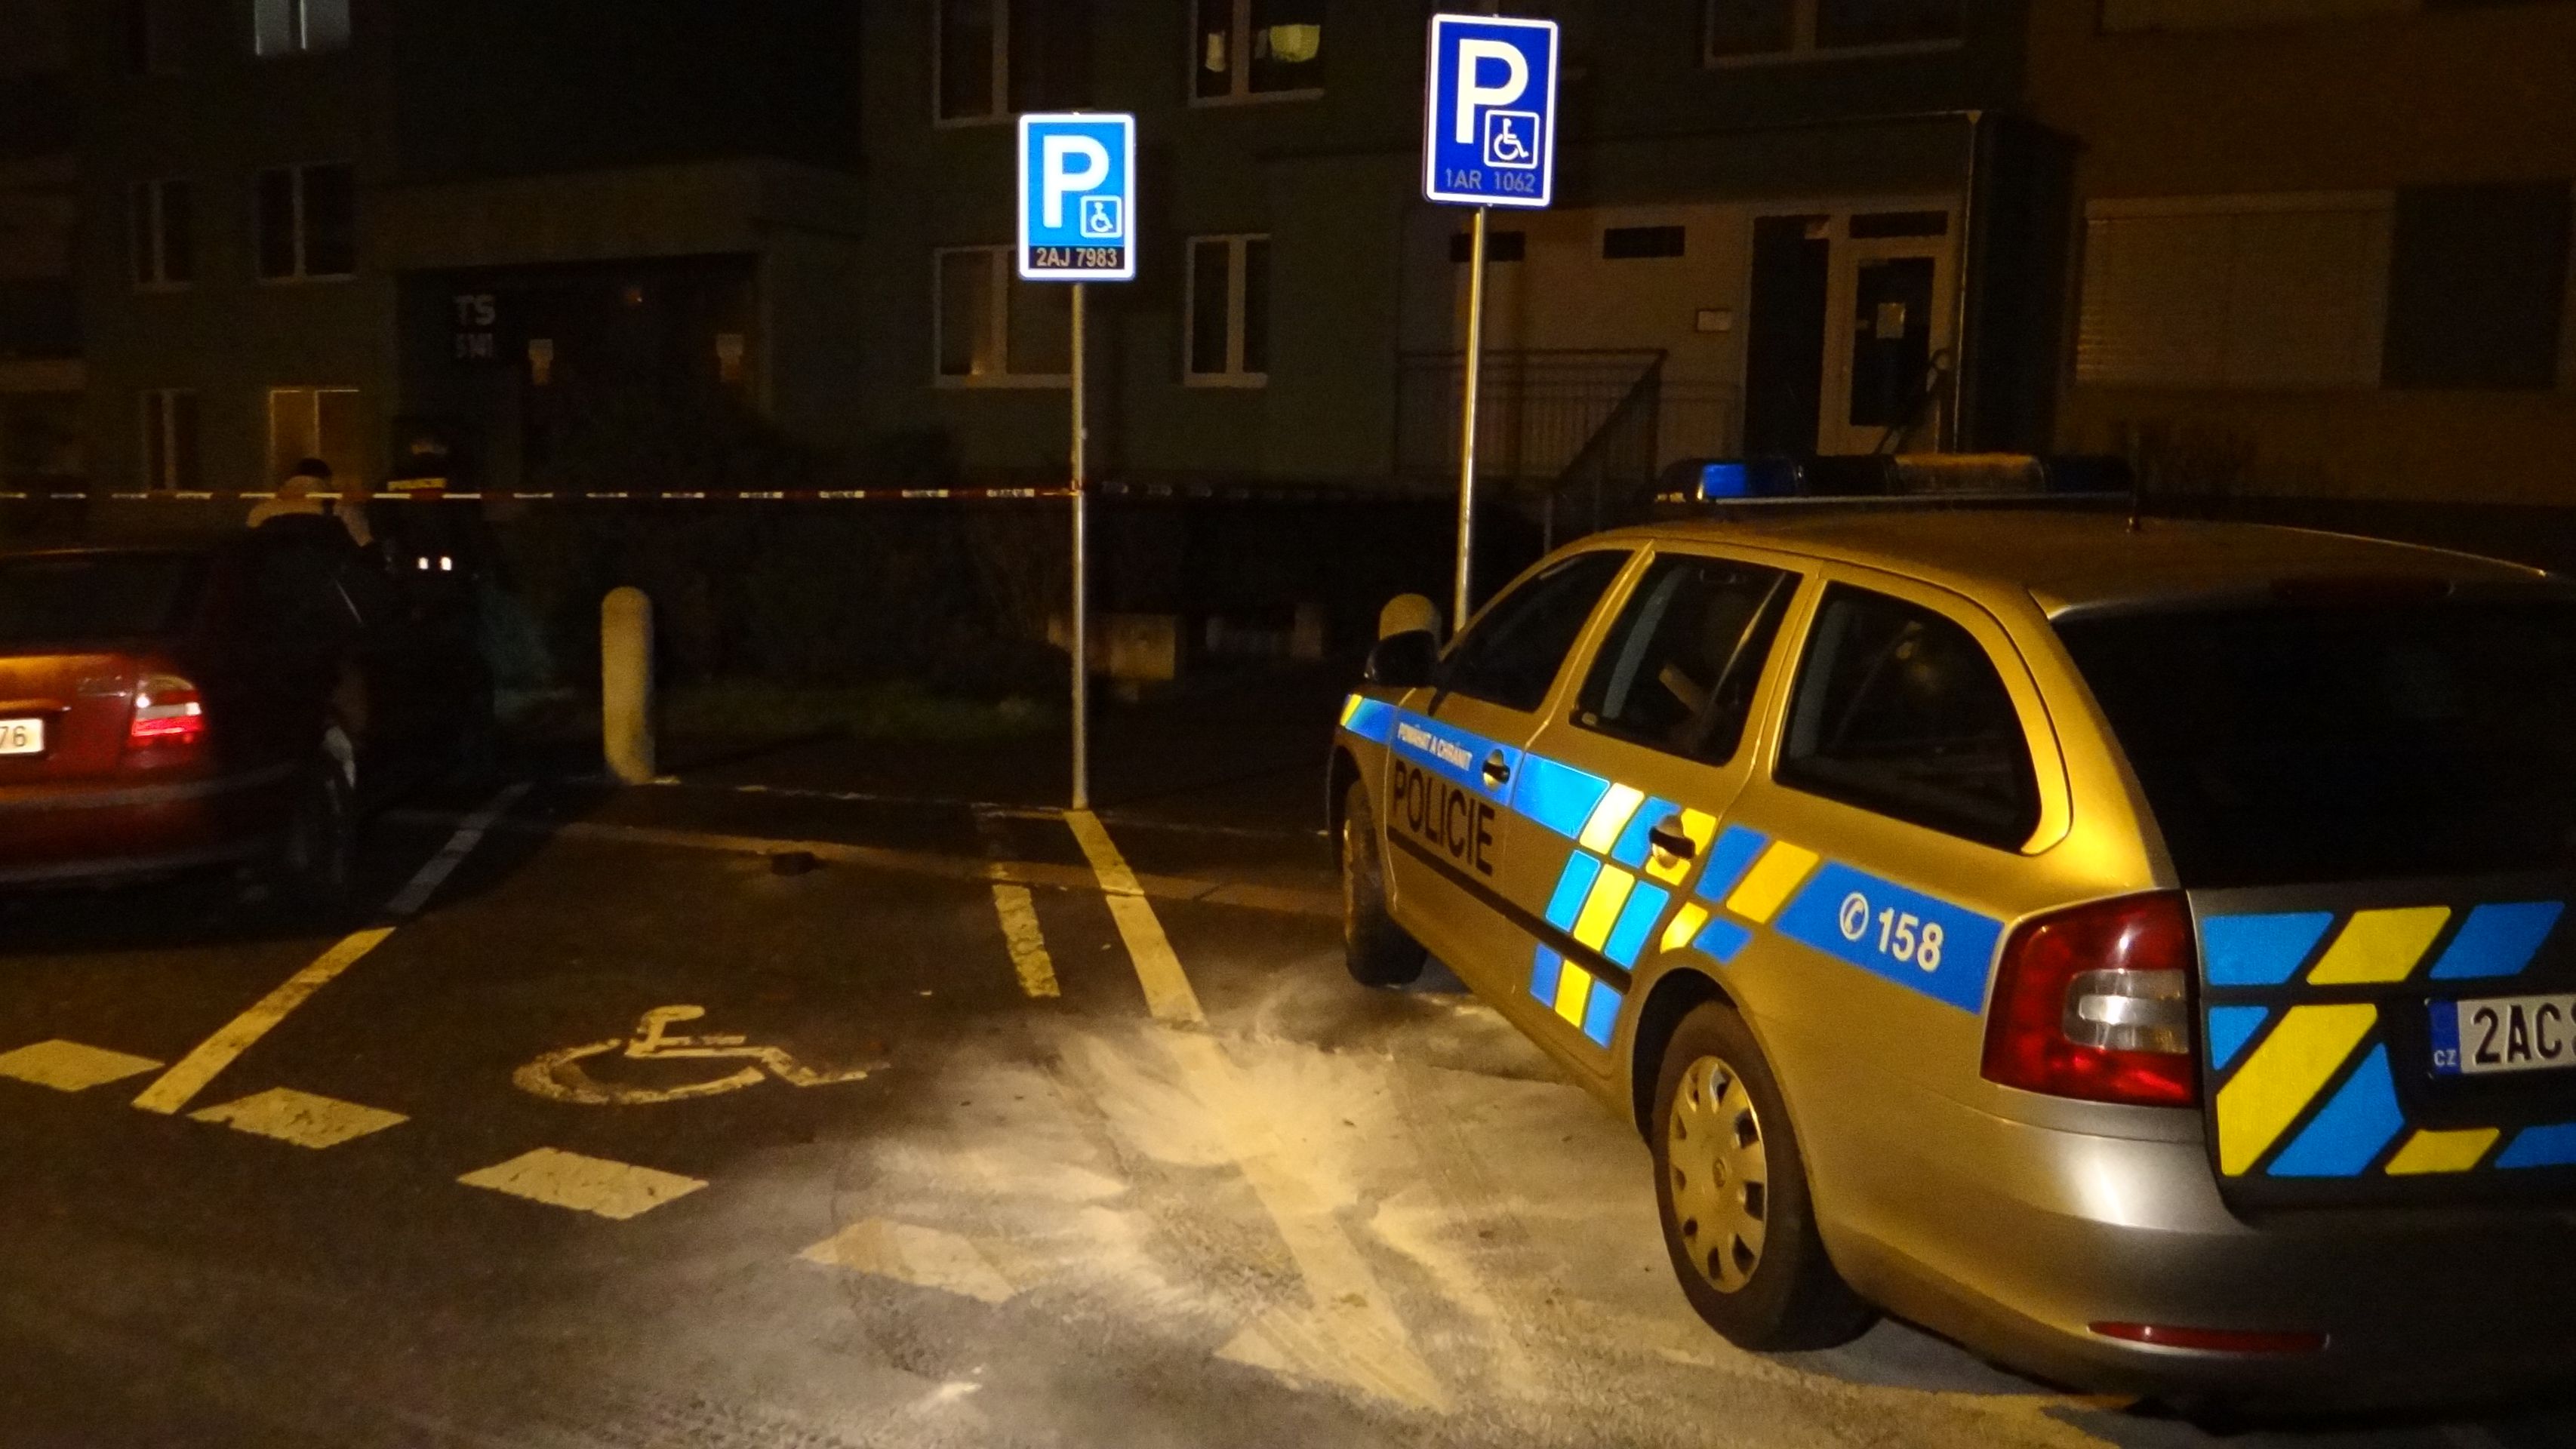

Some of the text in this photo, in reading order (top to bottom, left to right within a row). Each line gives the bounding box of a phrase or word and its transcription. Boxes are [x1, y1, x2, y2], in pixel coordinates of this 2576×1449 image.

[1456, 38, 1528, 144] P
[1043, 134, 1109, 228] P
[1445, 168, 1536, 193] 1AR 1062
[1036, 248, 1117, 267] 2AJ 7983
[452, 294, 496, 326] TS
[1394, 761, 1495, 876] POLICIE
[1879, 907, 1944, 973] 158
[2433, 1049, 2457, 1067] CZ
